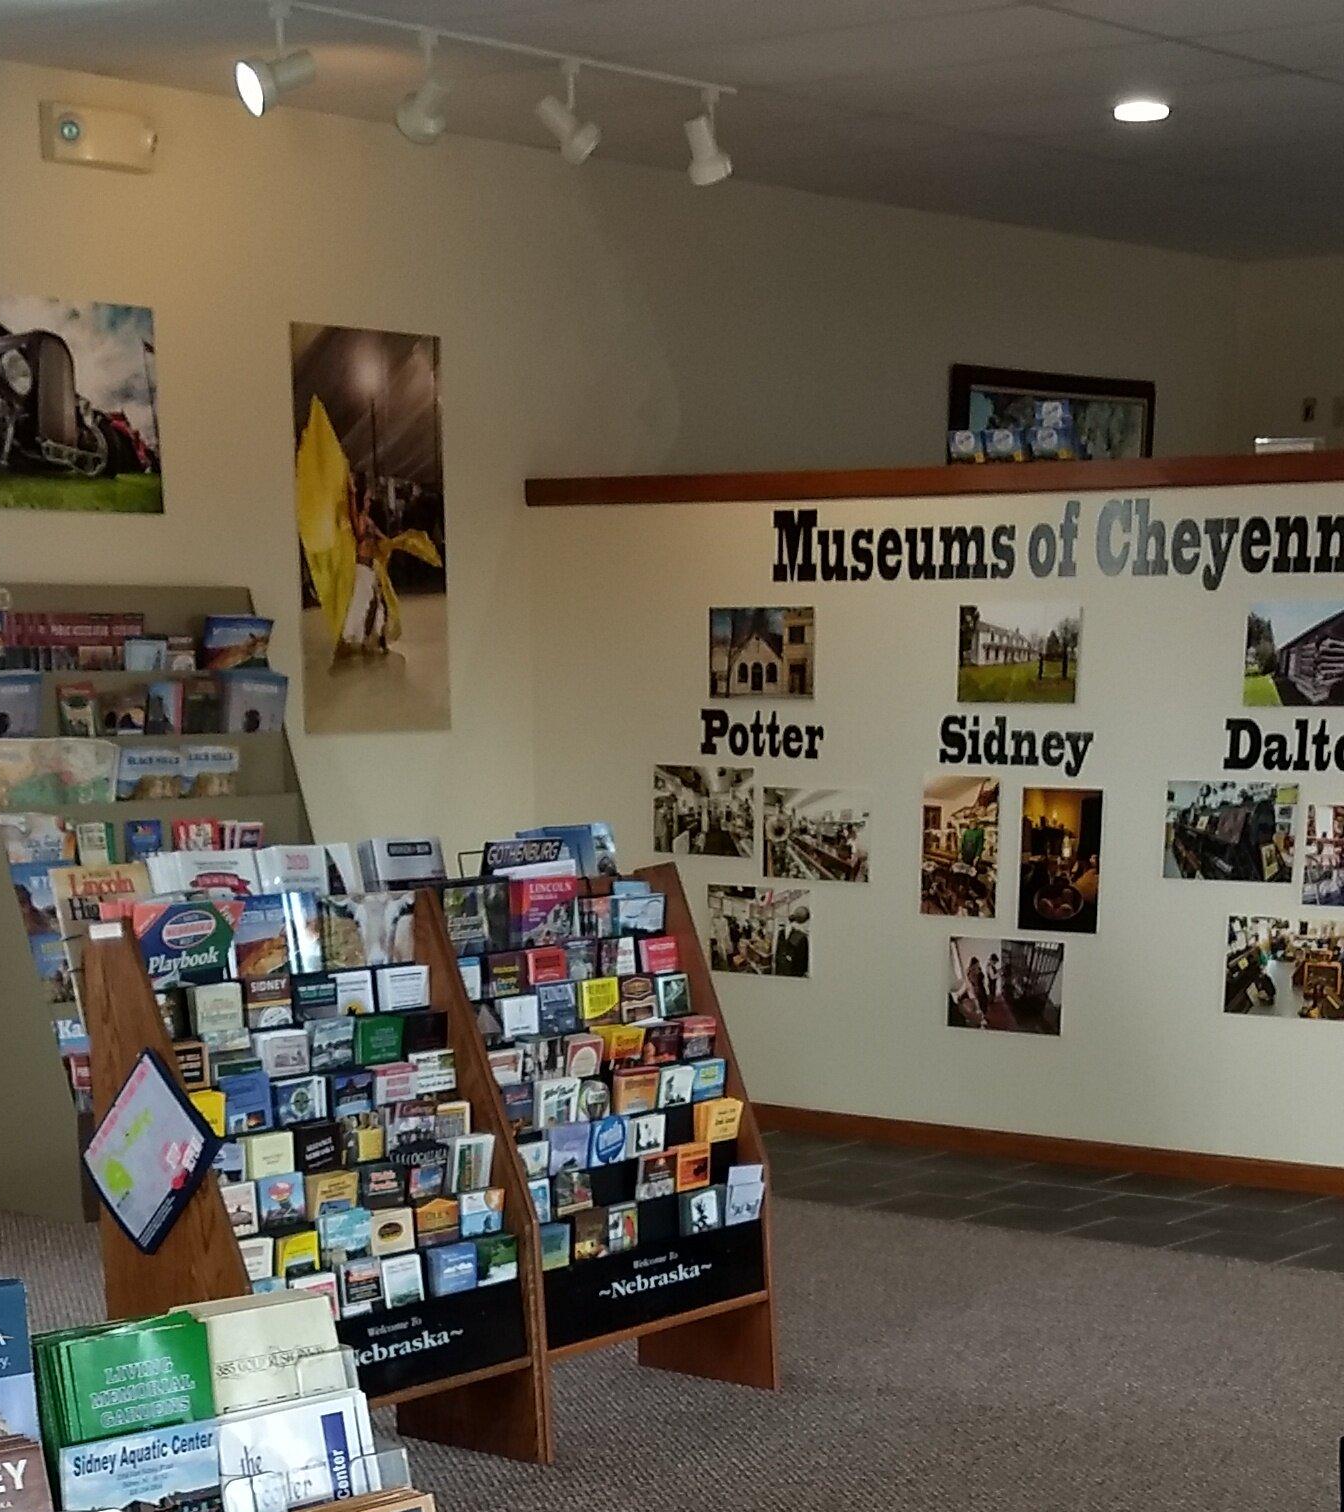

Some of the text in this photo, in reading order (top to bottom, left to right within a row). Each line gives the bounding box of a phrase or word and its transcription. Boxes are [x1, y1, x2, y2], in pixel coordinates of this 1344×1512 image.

[772, 508, 1015, 582] Museums
[1029, 500, 1080, 577] of
[700, 708, 824, 759] Potter
[939, 714, 1094, 776] Sidney
[487, 841, 561, 865] GOTHENBURG
[68, 875, 135, 896] Lincoln
[148, 946, 219, 976] Playbook
[251, 977, 287, 994] SIDNEY
[367, 1316, 423, 1337] Welcome To
[104, 1357, 173, 1384] LIVING
[89, 1373, 196, 1410] MEMORIAL
[100, 1397, 191, 1428] GARDENS
[73, 1431, 213, 1478] Sidney Aquatic Center
